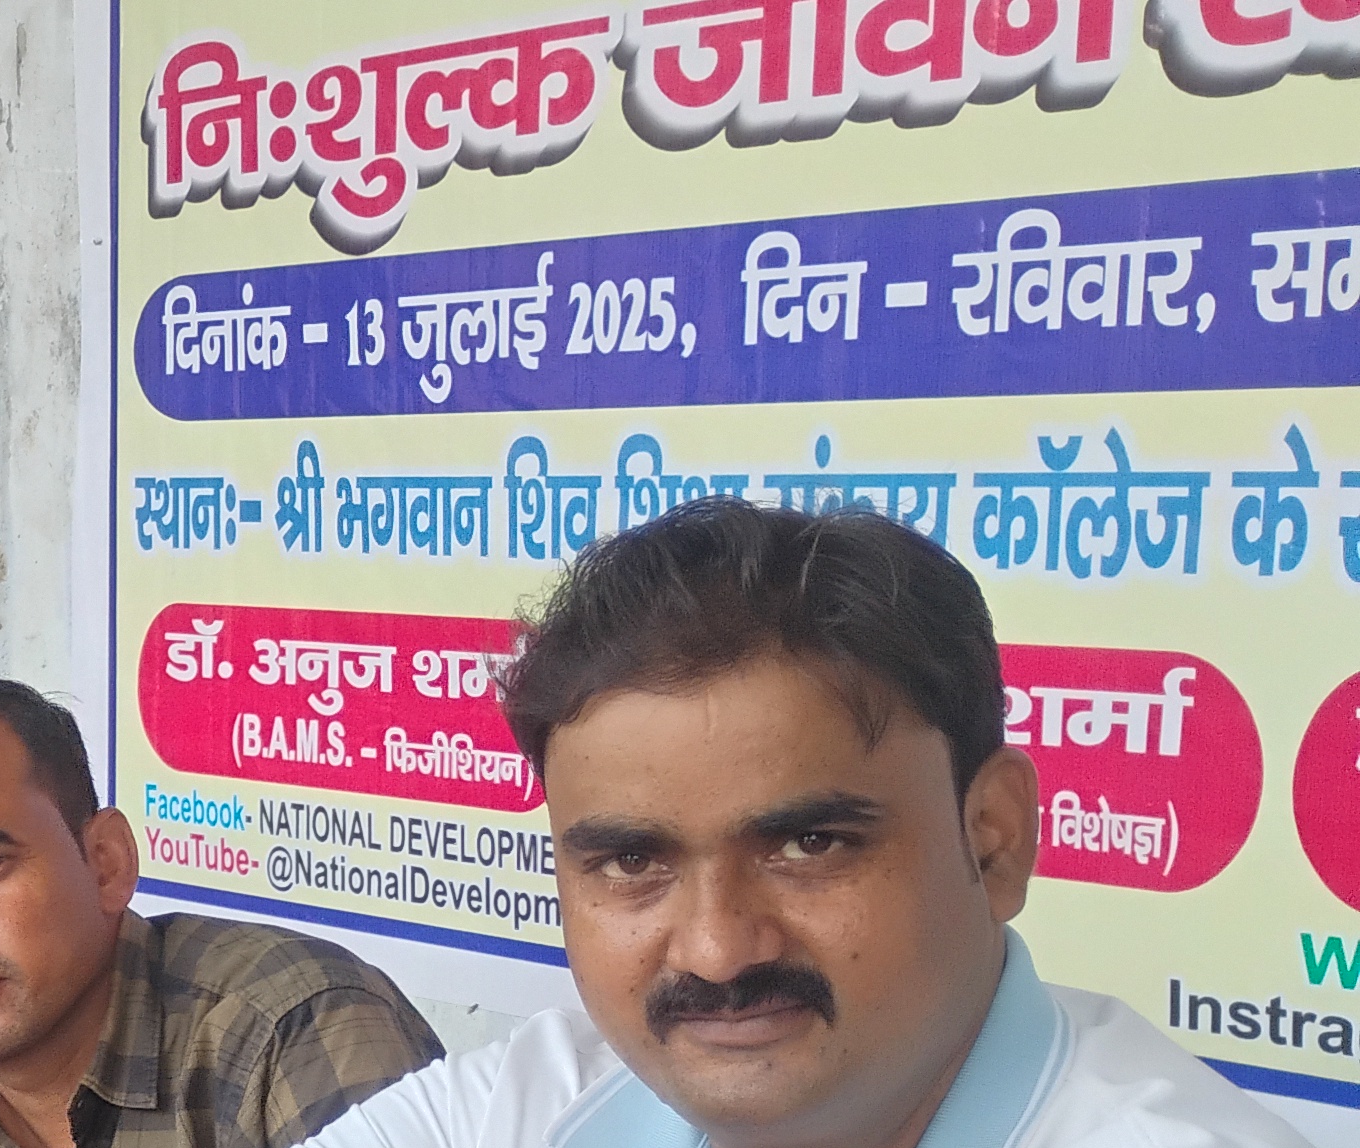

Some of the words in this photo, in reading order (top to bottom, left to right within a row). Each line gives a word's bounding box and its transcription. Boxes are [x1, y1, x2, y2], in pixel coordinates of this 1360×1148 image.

[156, 16, 610, 219] निःशुल्क
[162, 283, 291, 375] दिनांक
[303, 323, 328, 343] -
[344, 298, 385, 367] 13
[398, 251, 554, 403] जुलाई
[565, 277, 697, 359] 2025,
[740, 230, 868, 346] दिन
[884, 281, 928, 308] -
[951, 208, 1217, 336] रविवार,
[274, 439, 326, 554] श्री
[335, 475, 493, 558] भगवान
[503, 435, 603, 560] शिव
[972, 425, 1212, 580] कॉलेज
[1231, 423, 1321, 577] के
[164, 618, 235, 682] डॉ.
[247, 638, 398, 716] अनुज
[1004, 666, 1197, 757] शर्मा
[231, 712, 353, 769] (B.A.M.S.
[382, 726, 534, 802] फिजीशियन)
[144, 783, 253, 832] Facebook-
[258, 797, 382, 852] NATIONAL
[144, 824, 260, 879] YouTube-
[1168, 978, 1360, 1058] Instra
